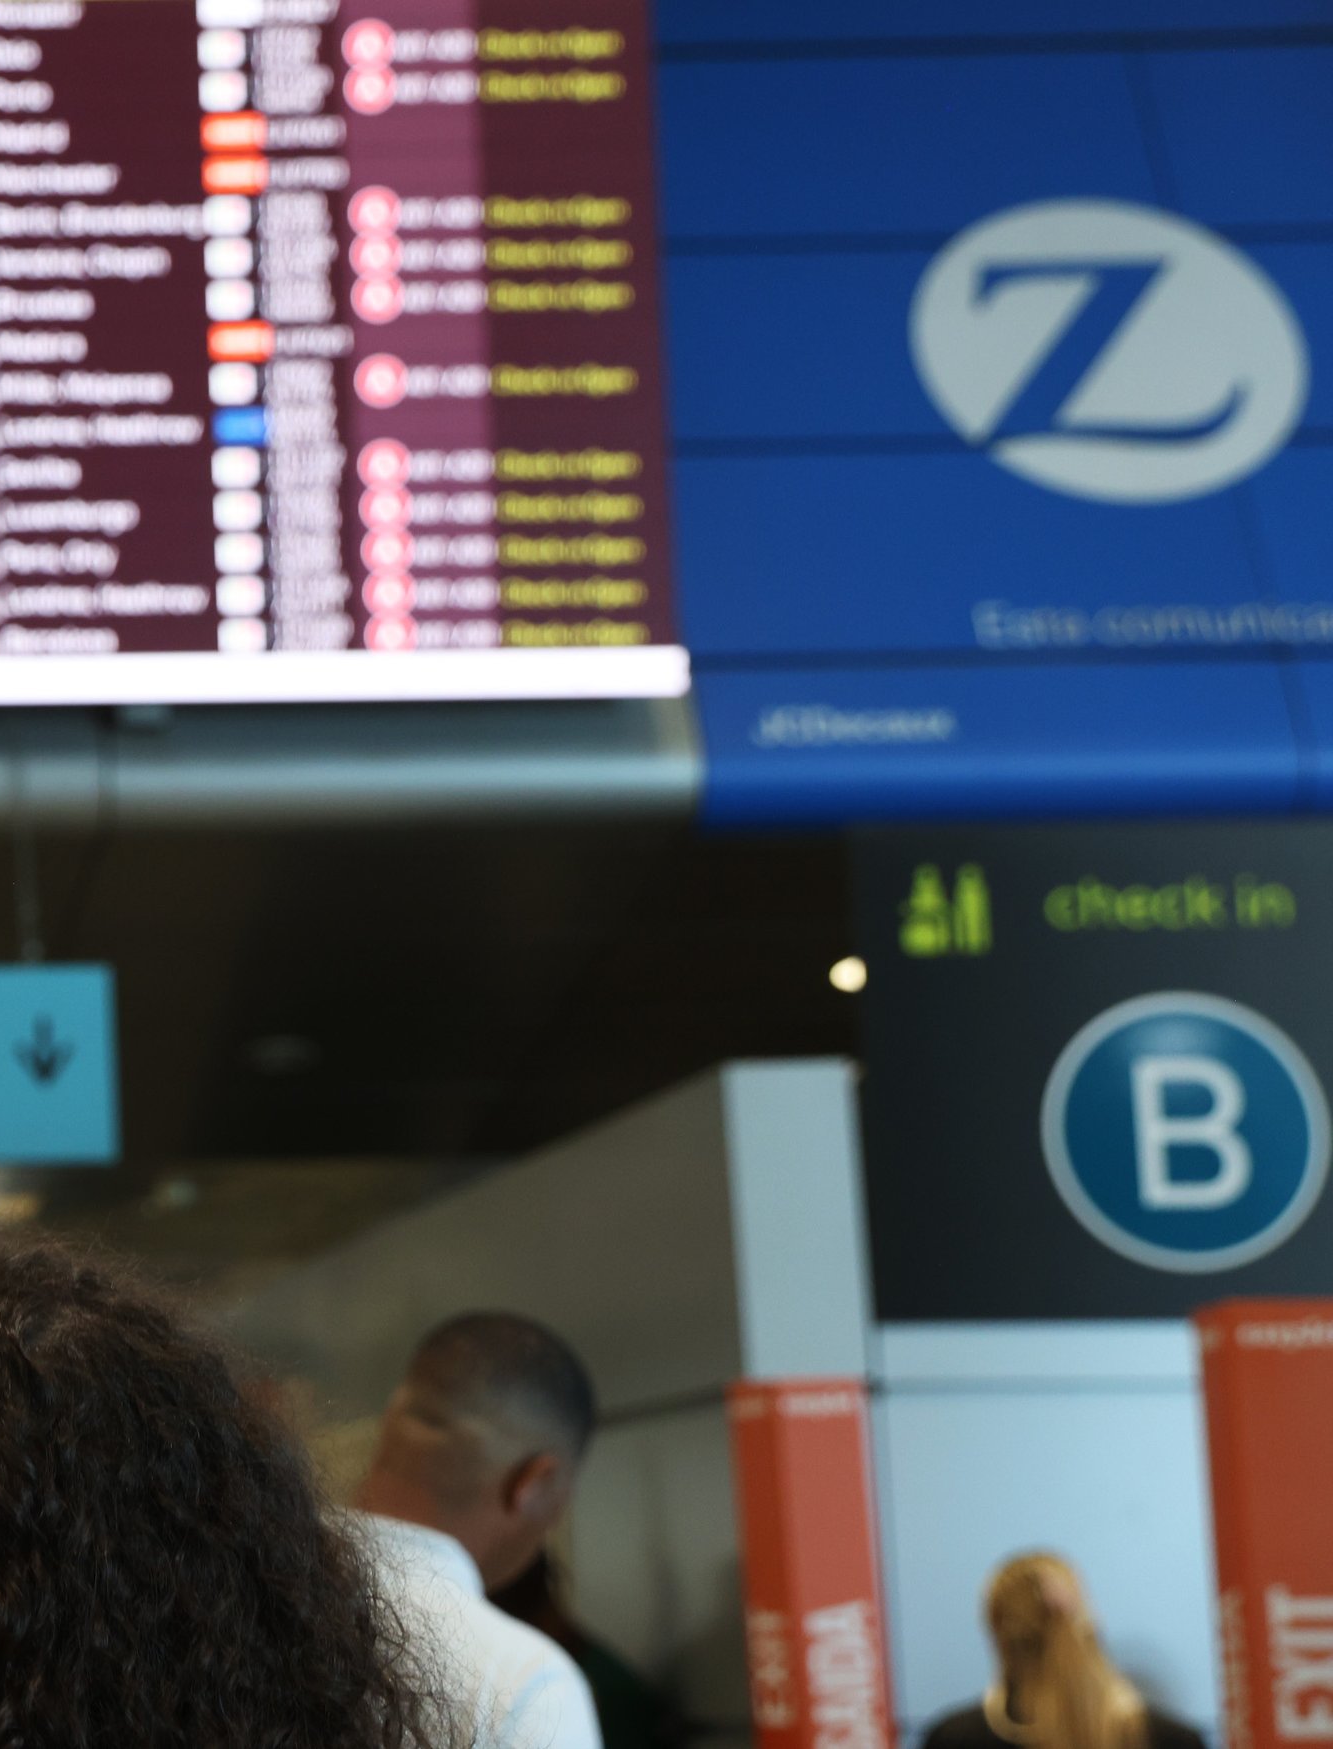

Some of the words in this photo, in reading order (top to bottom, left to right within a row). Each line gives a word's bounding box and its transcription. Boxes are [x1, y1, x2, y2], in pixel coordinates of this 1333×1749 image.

[1044, 876, 1227, 931] check
[1236, 874, 1296, 929] in
[1132, 1054, 1253, 1210] B
